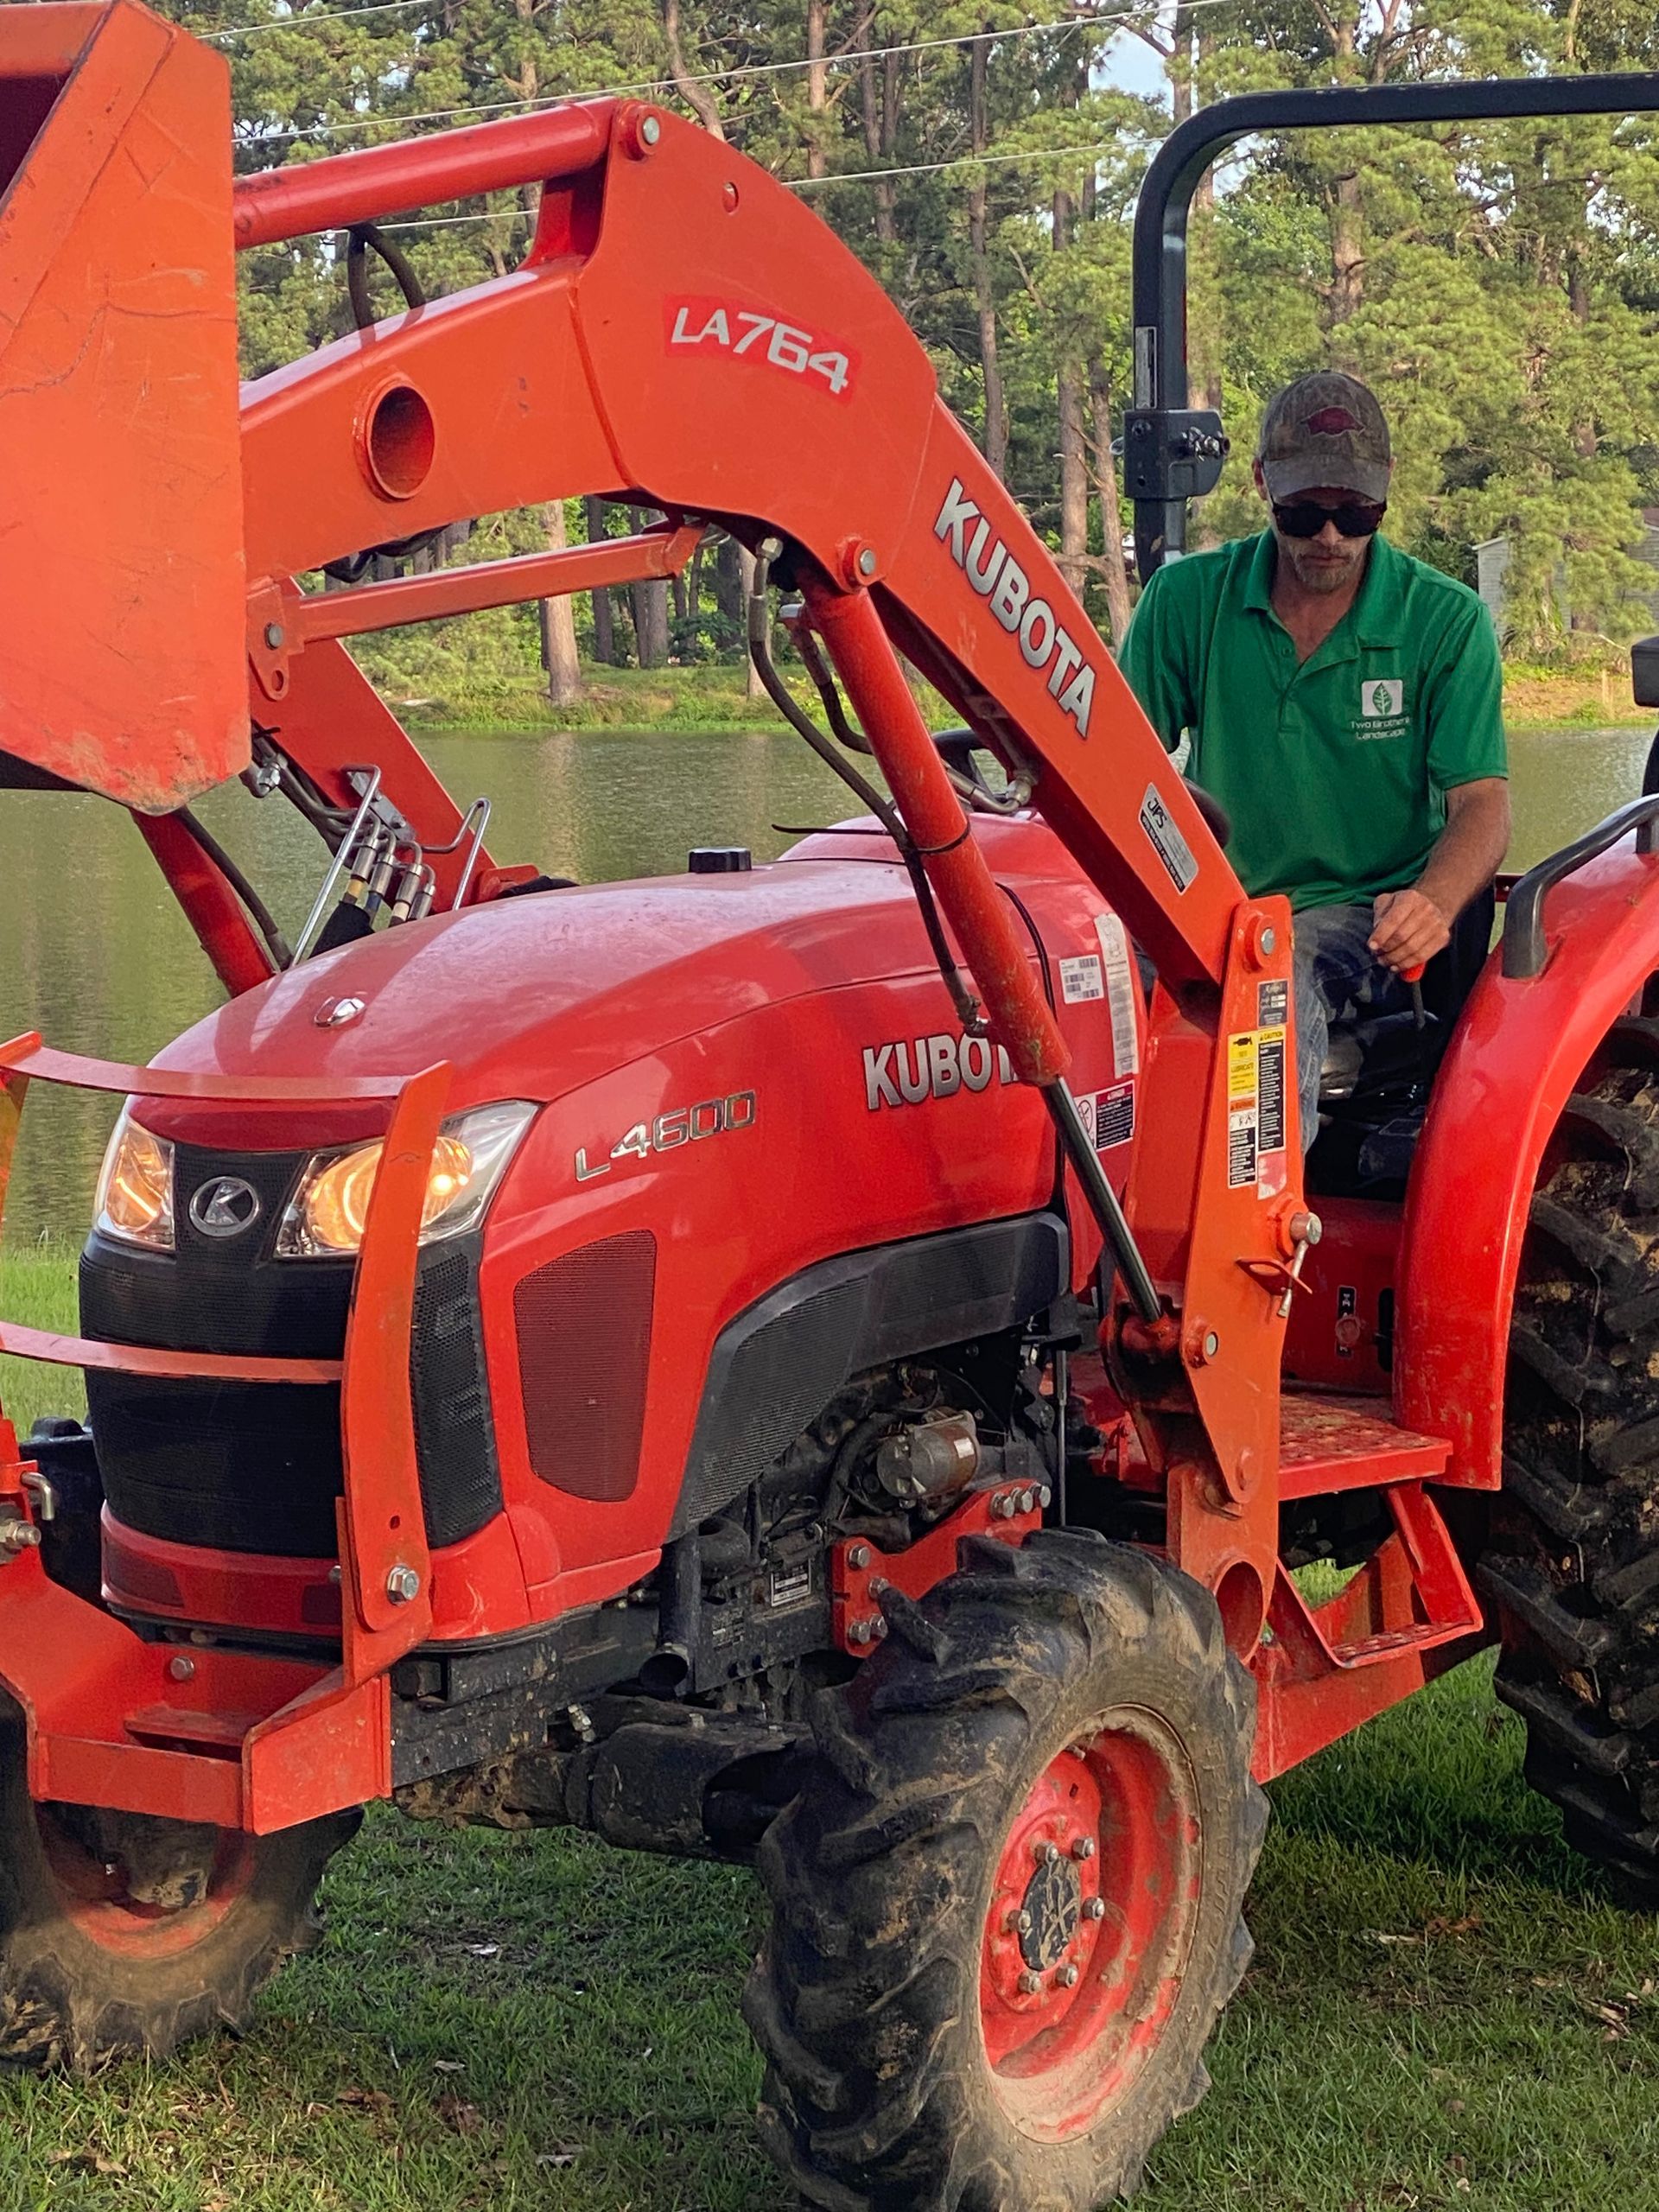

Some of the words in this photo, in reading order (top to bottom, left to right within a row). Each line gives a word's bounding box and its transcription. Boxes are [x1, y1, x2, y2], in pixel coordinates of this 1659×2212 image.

[671, 307, 850, 394] LA764
[934, 477, 1096, 739] KUBOTA
[1351, 721, 1372, 729] Two
[862, 1033, 1020, 1110] KUBO
[575, 1090, 756, 1182] L4600
